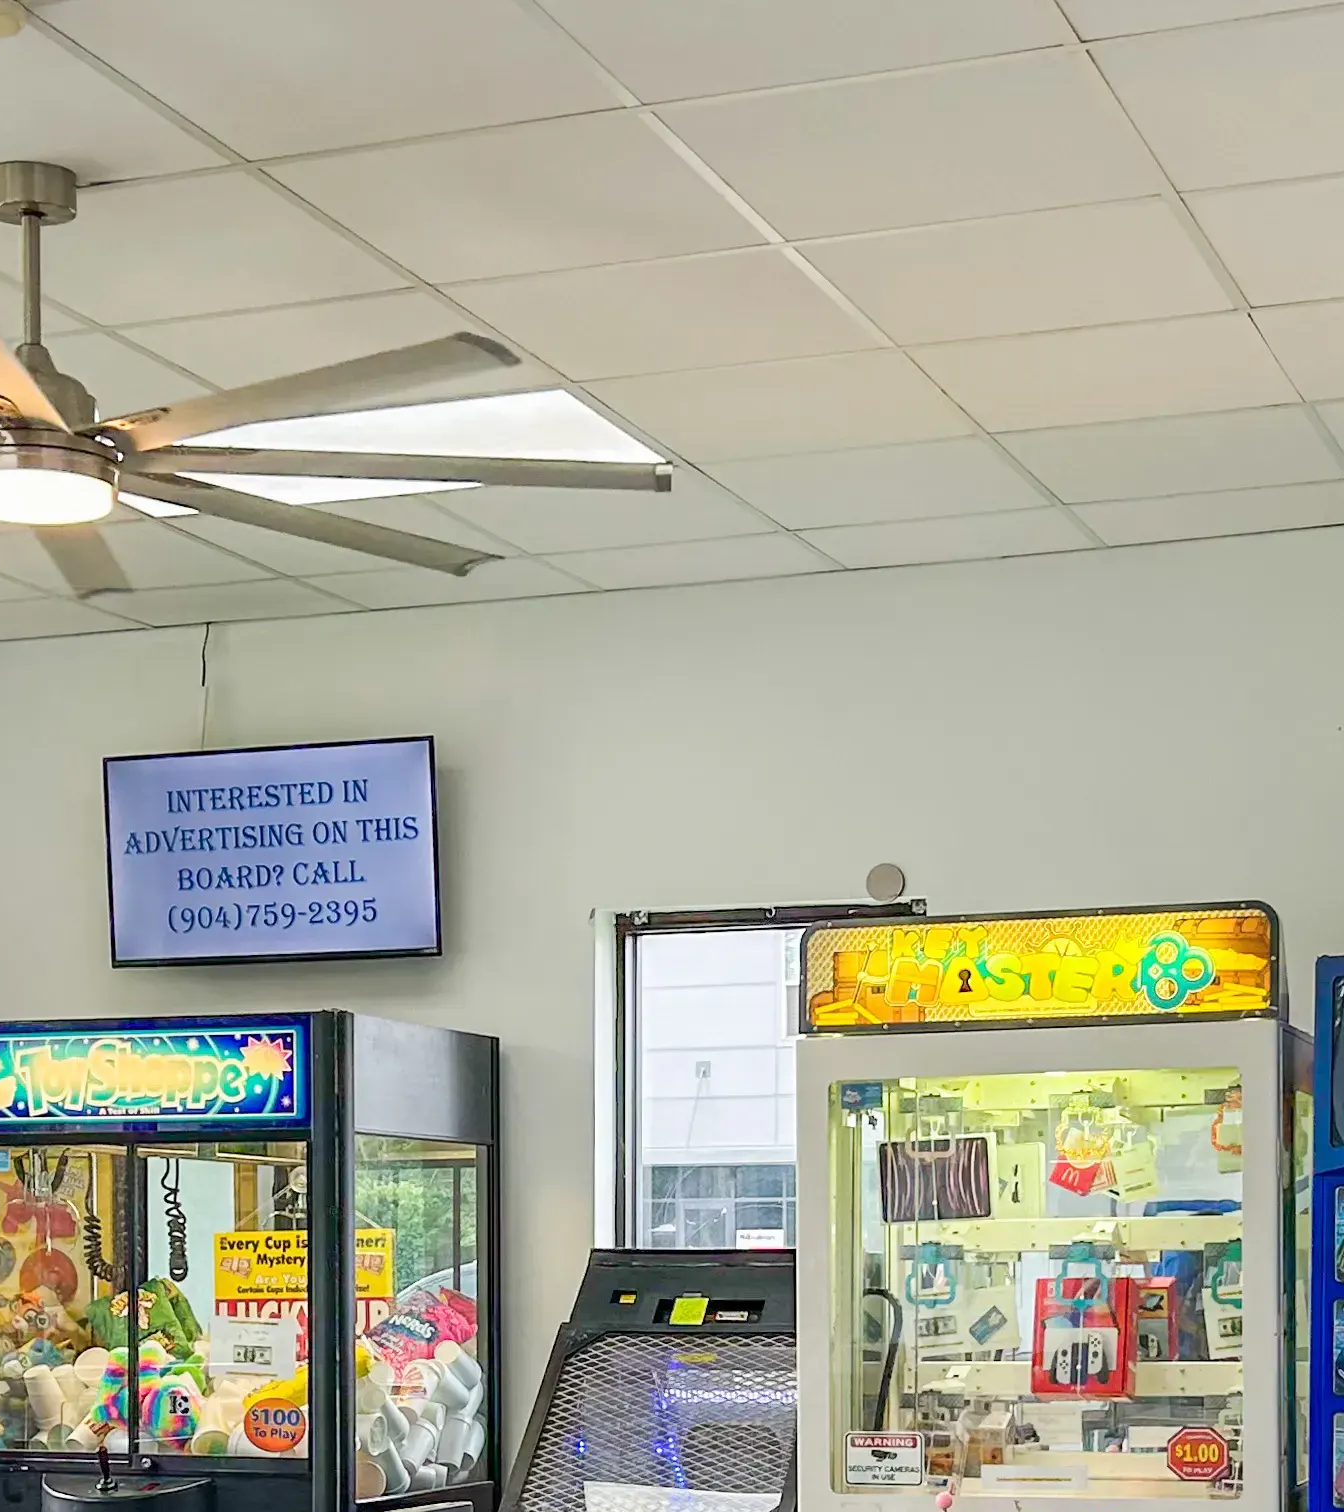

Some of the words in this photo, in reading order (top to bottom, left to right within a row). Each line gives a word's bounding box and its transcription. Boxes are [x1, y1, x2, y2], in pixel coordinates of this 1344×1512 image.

[167, 780, 334, 813] INTERESTED
[342, 779, 369, 803] IN
[124, 823, 304, 855] ADVERTISING
[312, 820, 348, 845] ON
[356, 817, 420, 843] THIS
[177, 864, 284, 891] BOARD?
[292, 860, 365, 886] CALL
[167, 898, 378, 933] (904)759-2395
[891, 925, 989, 960] KEY
[885, 950, 1140, 1006] MASTER
[219, 1236, 260, 1253] Every
[265, 1236, 291, 1253] Cup
[257, 1253, 306, 1268] Mystery
[255, 1274, 278, 1285] Are
[283, 1273, 307, 1285] You
[251, 1408, 300, 1427] $100
[253, 1427, 267, 1438] To
[271, 1428, 297, 1441] Play
[854, 1437, 914, 1447] WARNING
[1175, 1443, 1219, 1463] $1.00
[848, 1465, 882, 1473] SECURITY
